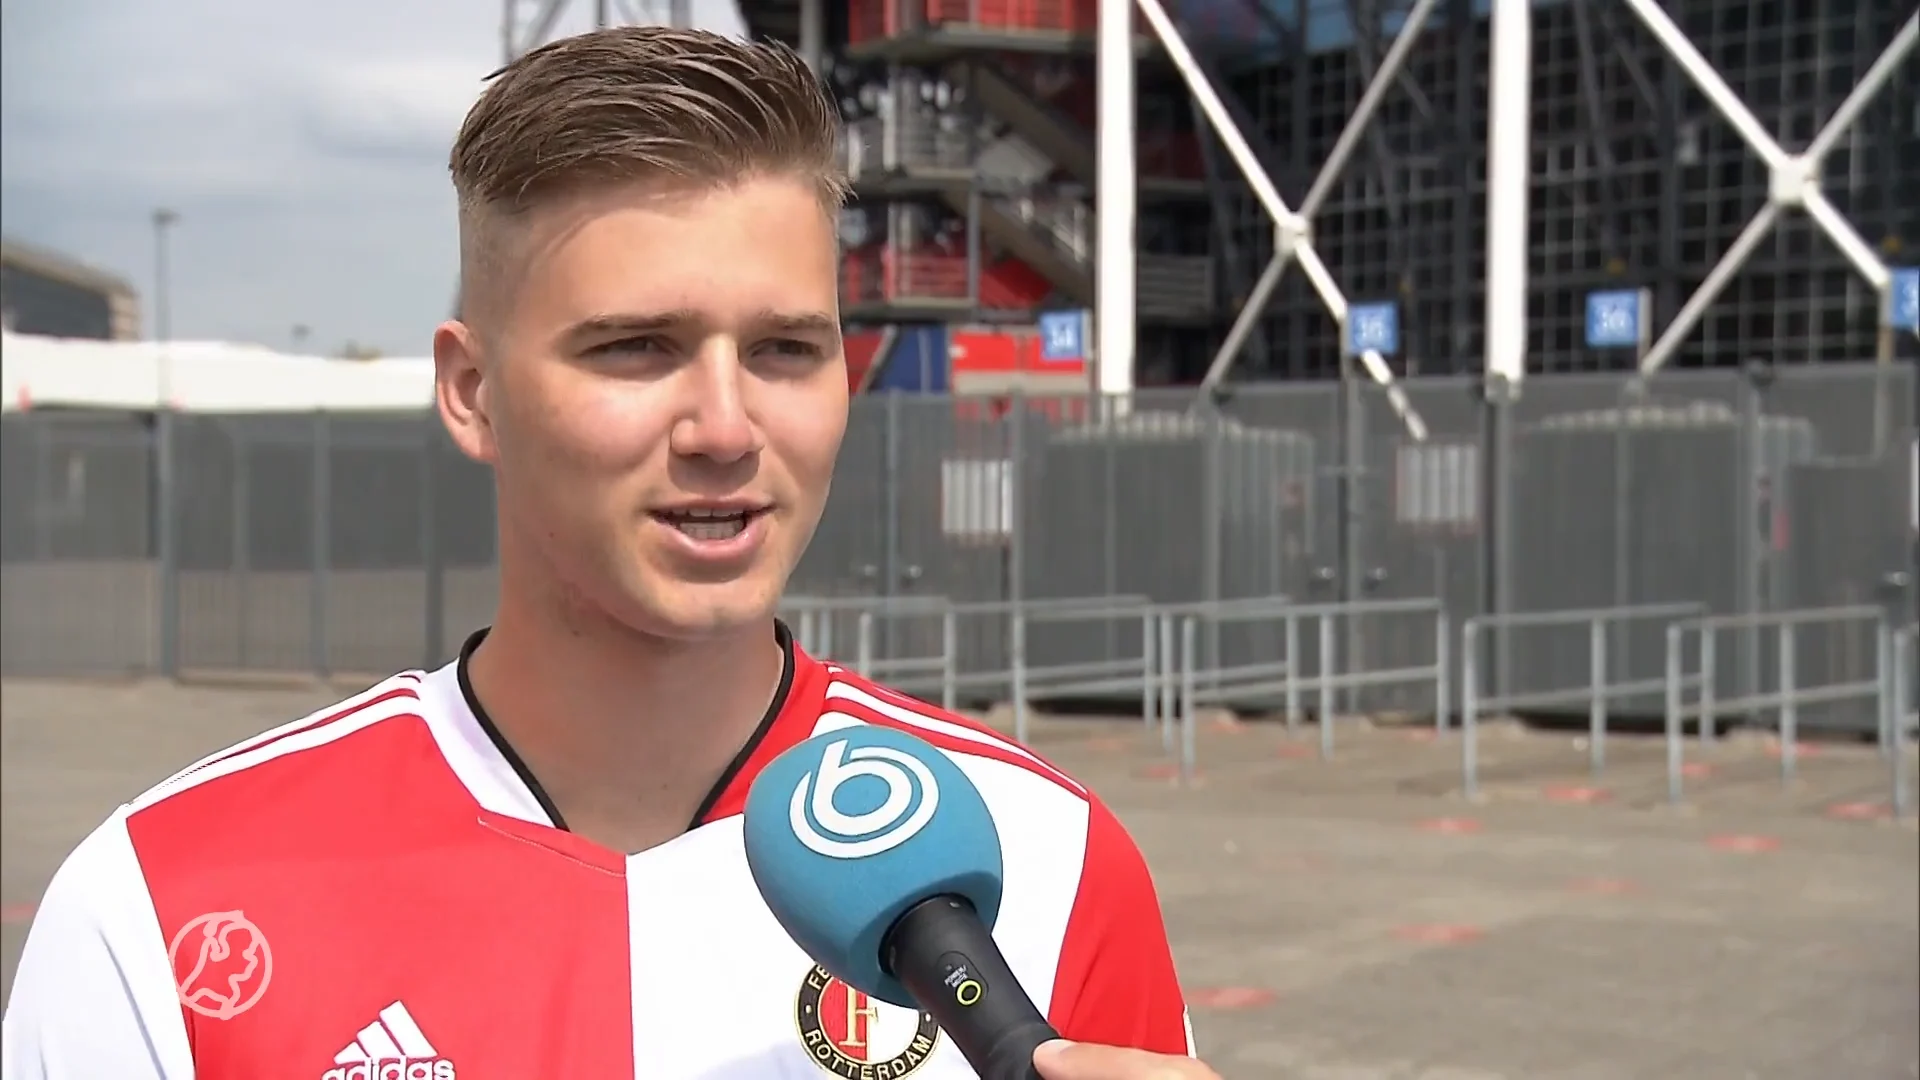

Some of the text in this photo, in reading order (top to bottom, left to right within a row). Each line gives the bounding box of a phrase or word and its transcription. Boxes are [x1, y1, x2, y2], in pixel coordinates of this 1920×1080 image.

[1596, 304, 1628, 335] 36
[808, 964, 830, 990] FE
[321, 1056, 456, 1080] adidas
[805, 1029, 933, 1080] ROTTERDAM
